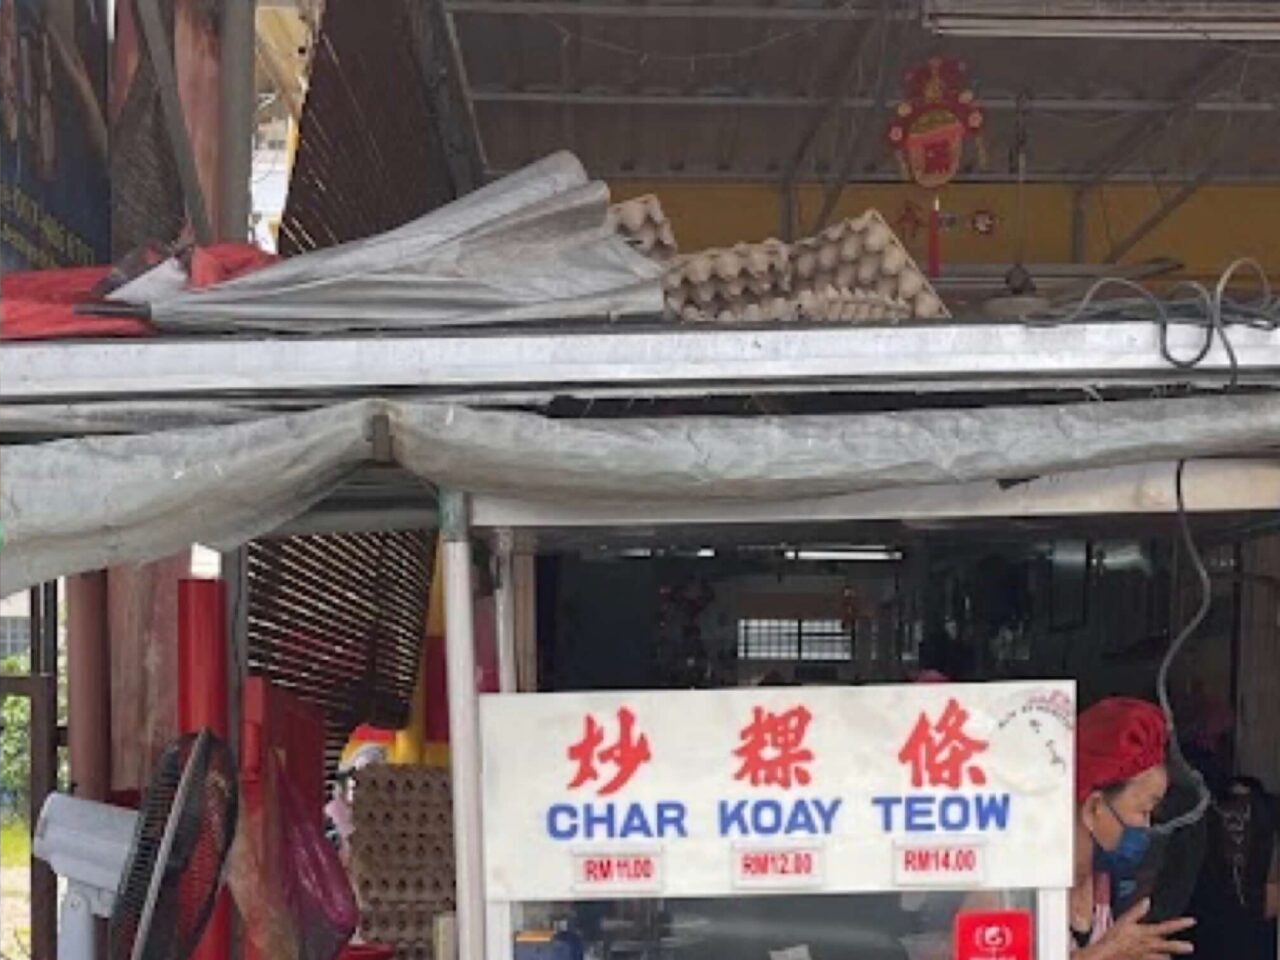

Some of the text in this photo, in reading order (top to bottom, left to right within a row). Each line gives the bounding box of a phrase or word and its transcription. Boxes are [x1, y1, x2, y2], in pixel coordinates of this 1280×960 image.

[567, 699, 988, 795] 炒粿條
[546, 794, 1010, 841] CHAR KOAY TEOW
